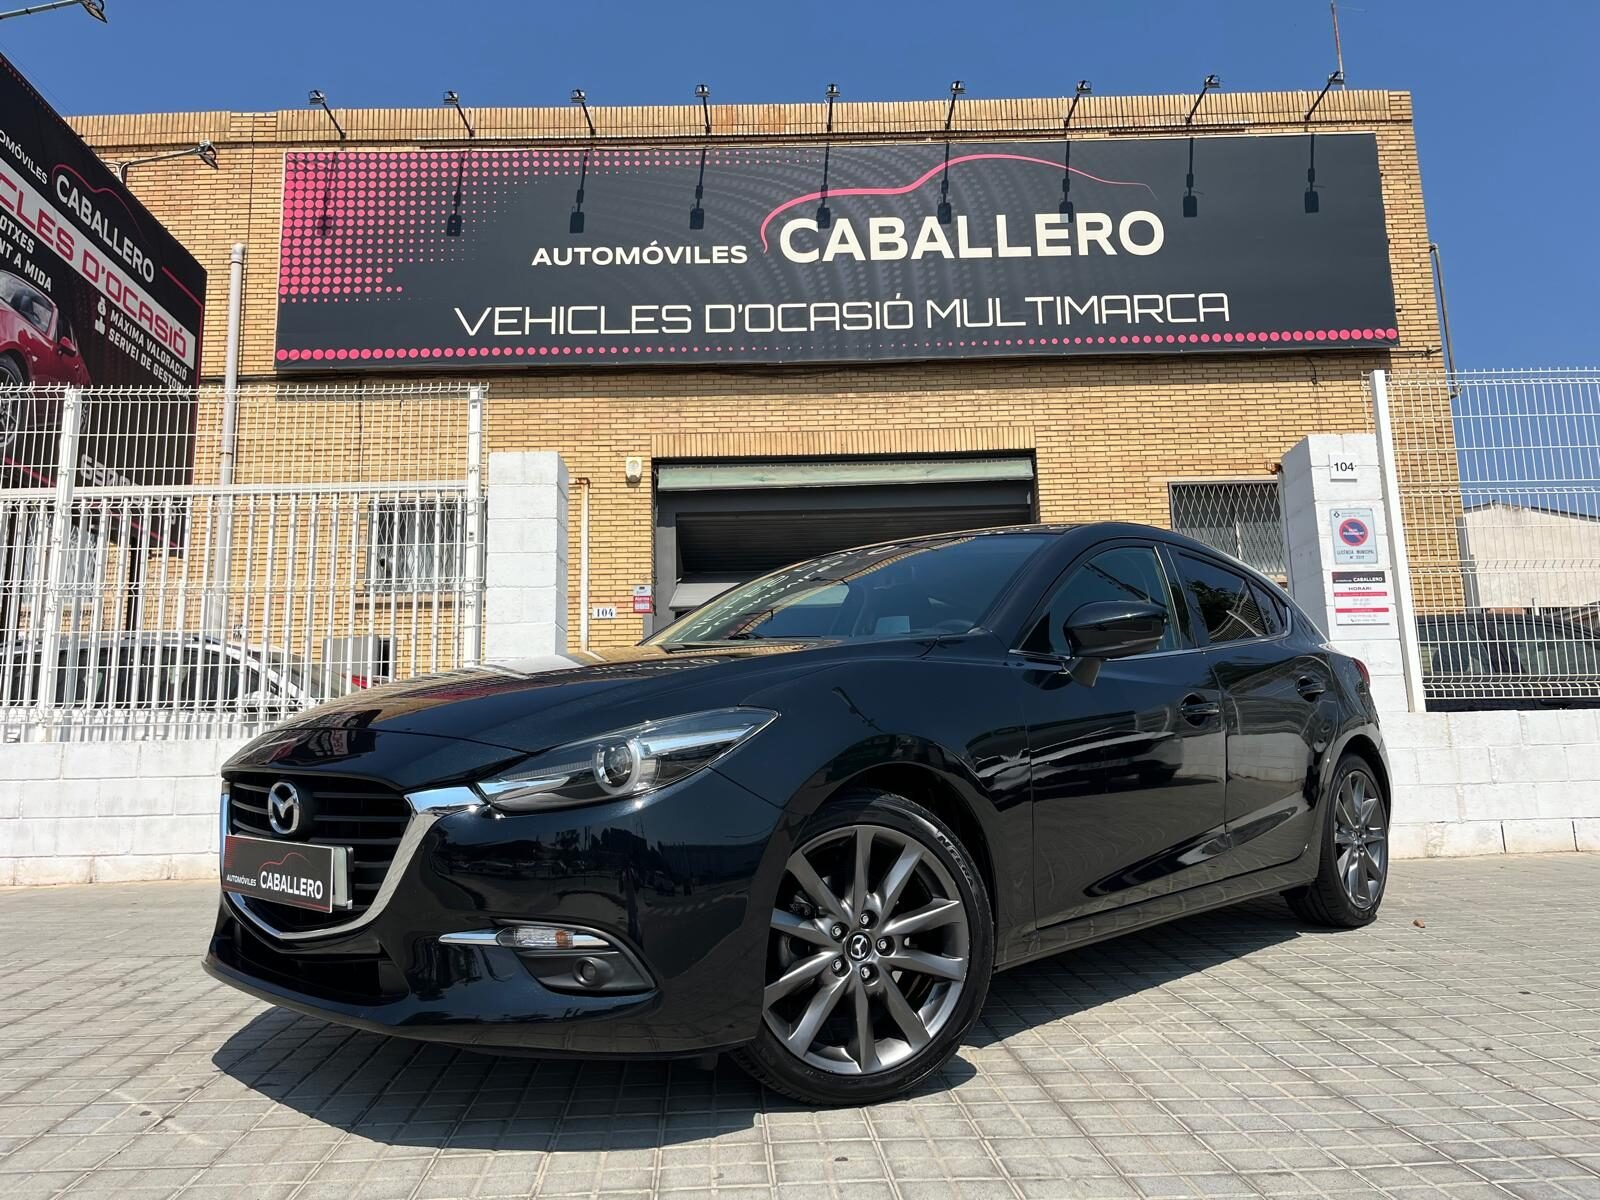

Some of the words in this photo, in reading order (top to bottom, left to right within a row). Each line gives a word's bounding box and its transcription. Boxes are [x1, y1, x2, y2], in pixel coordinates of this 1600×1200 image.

[56, 174, 155, 283] CABALLERO
[530, 240, 748, 266] AUTOMÓVILES
[779, 210, 1165, 263] CABALLERO
[13, 253, 22, 269] A
[24, 260, 52, 292] MIDA
[82, 249, 187, 358] D'OCASIÓ
[453, 304, 692, 337] VEHICLES
[704, 293, 914, 334] D'OCASIÓ
[926, 292, 1231, 329] MULTIMARCA
[108, 327, 139, 361] SERVEI
[140, 353, 152, 371] DE
[110, 309, 144, 348] MÀXIMA
[146, 338, 188, 381] VALORACIÓ
[1334, 461, 1355, 472] 104
[596, 607, 613, 617] 104
[260, 871, 323, 900] CABALLERO
